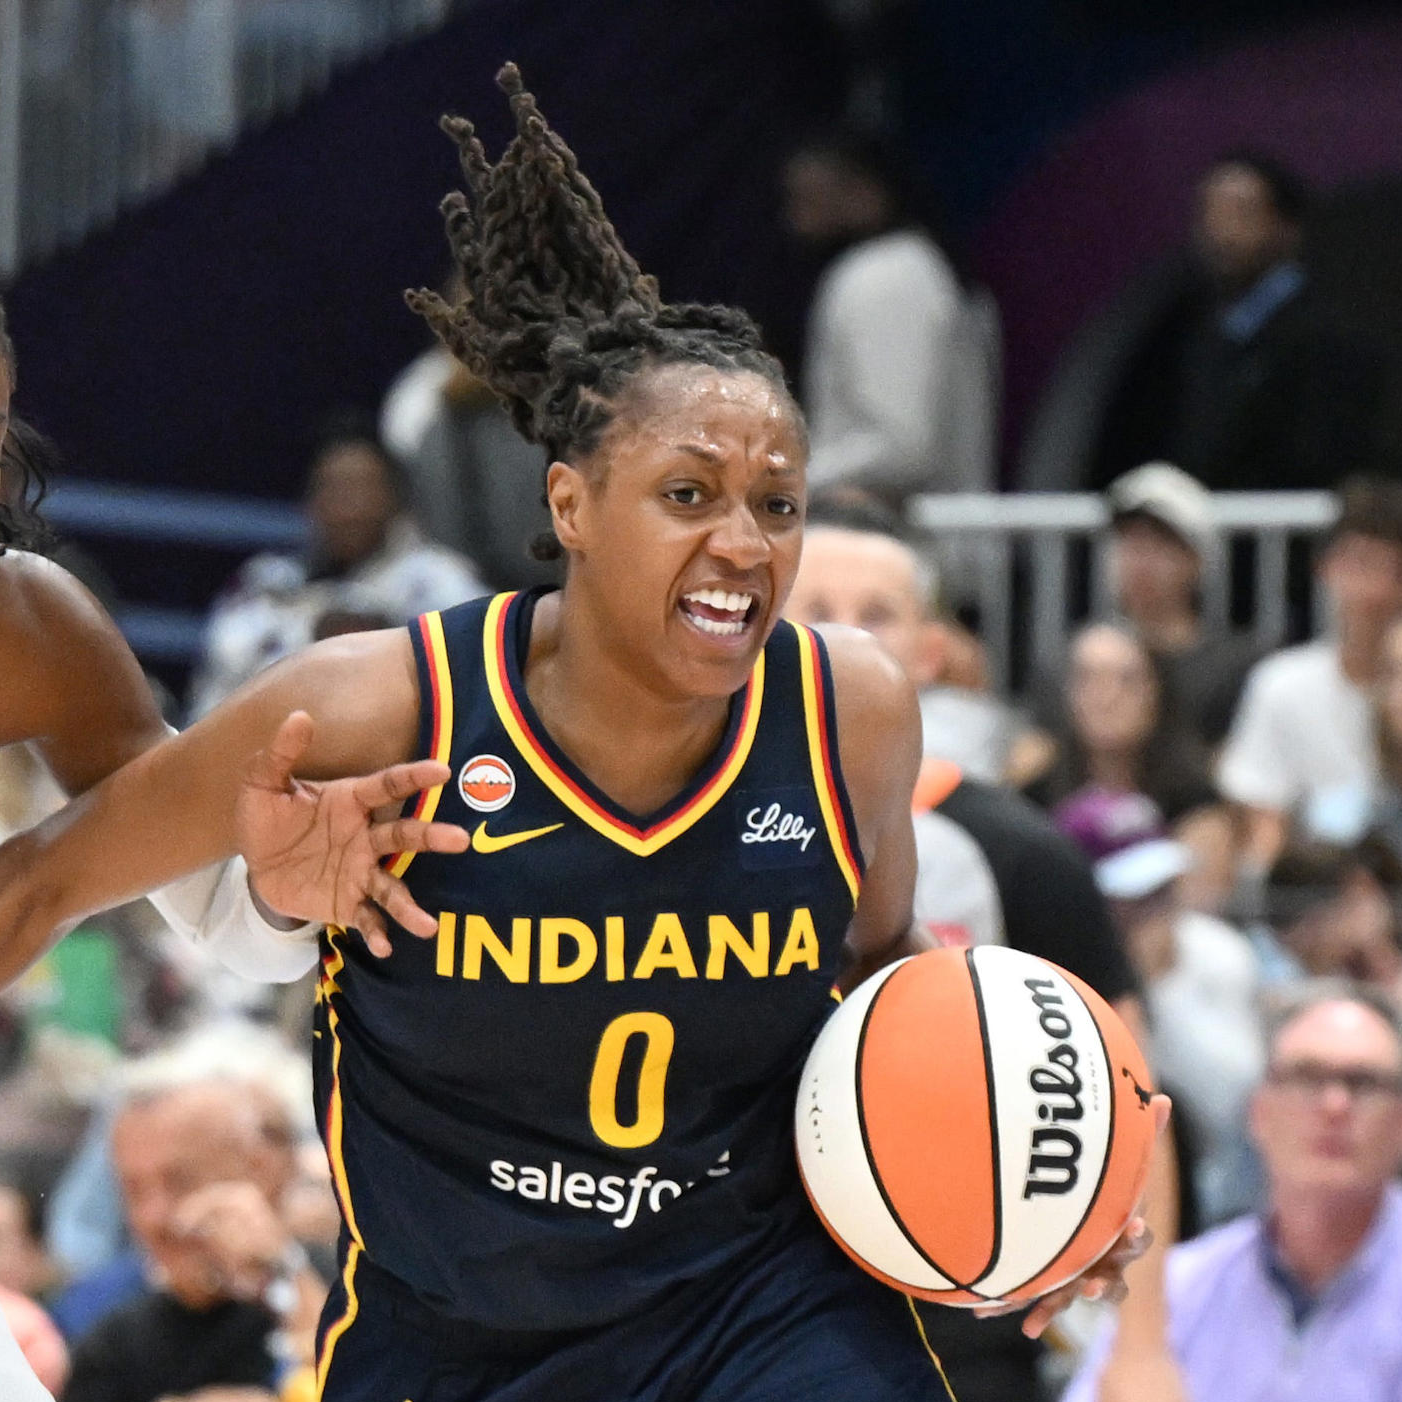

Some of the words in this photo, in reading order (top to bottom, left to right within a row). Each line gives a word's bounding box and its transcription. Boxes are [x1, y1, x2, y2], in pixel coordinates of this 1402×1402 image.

[741, 802, 817, 852] Lilly
[436, 907, 820, 984] INDIANA
[589, 1011, 675, 1149] 0
[1022, 978, 1085, 1202] Wilson
